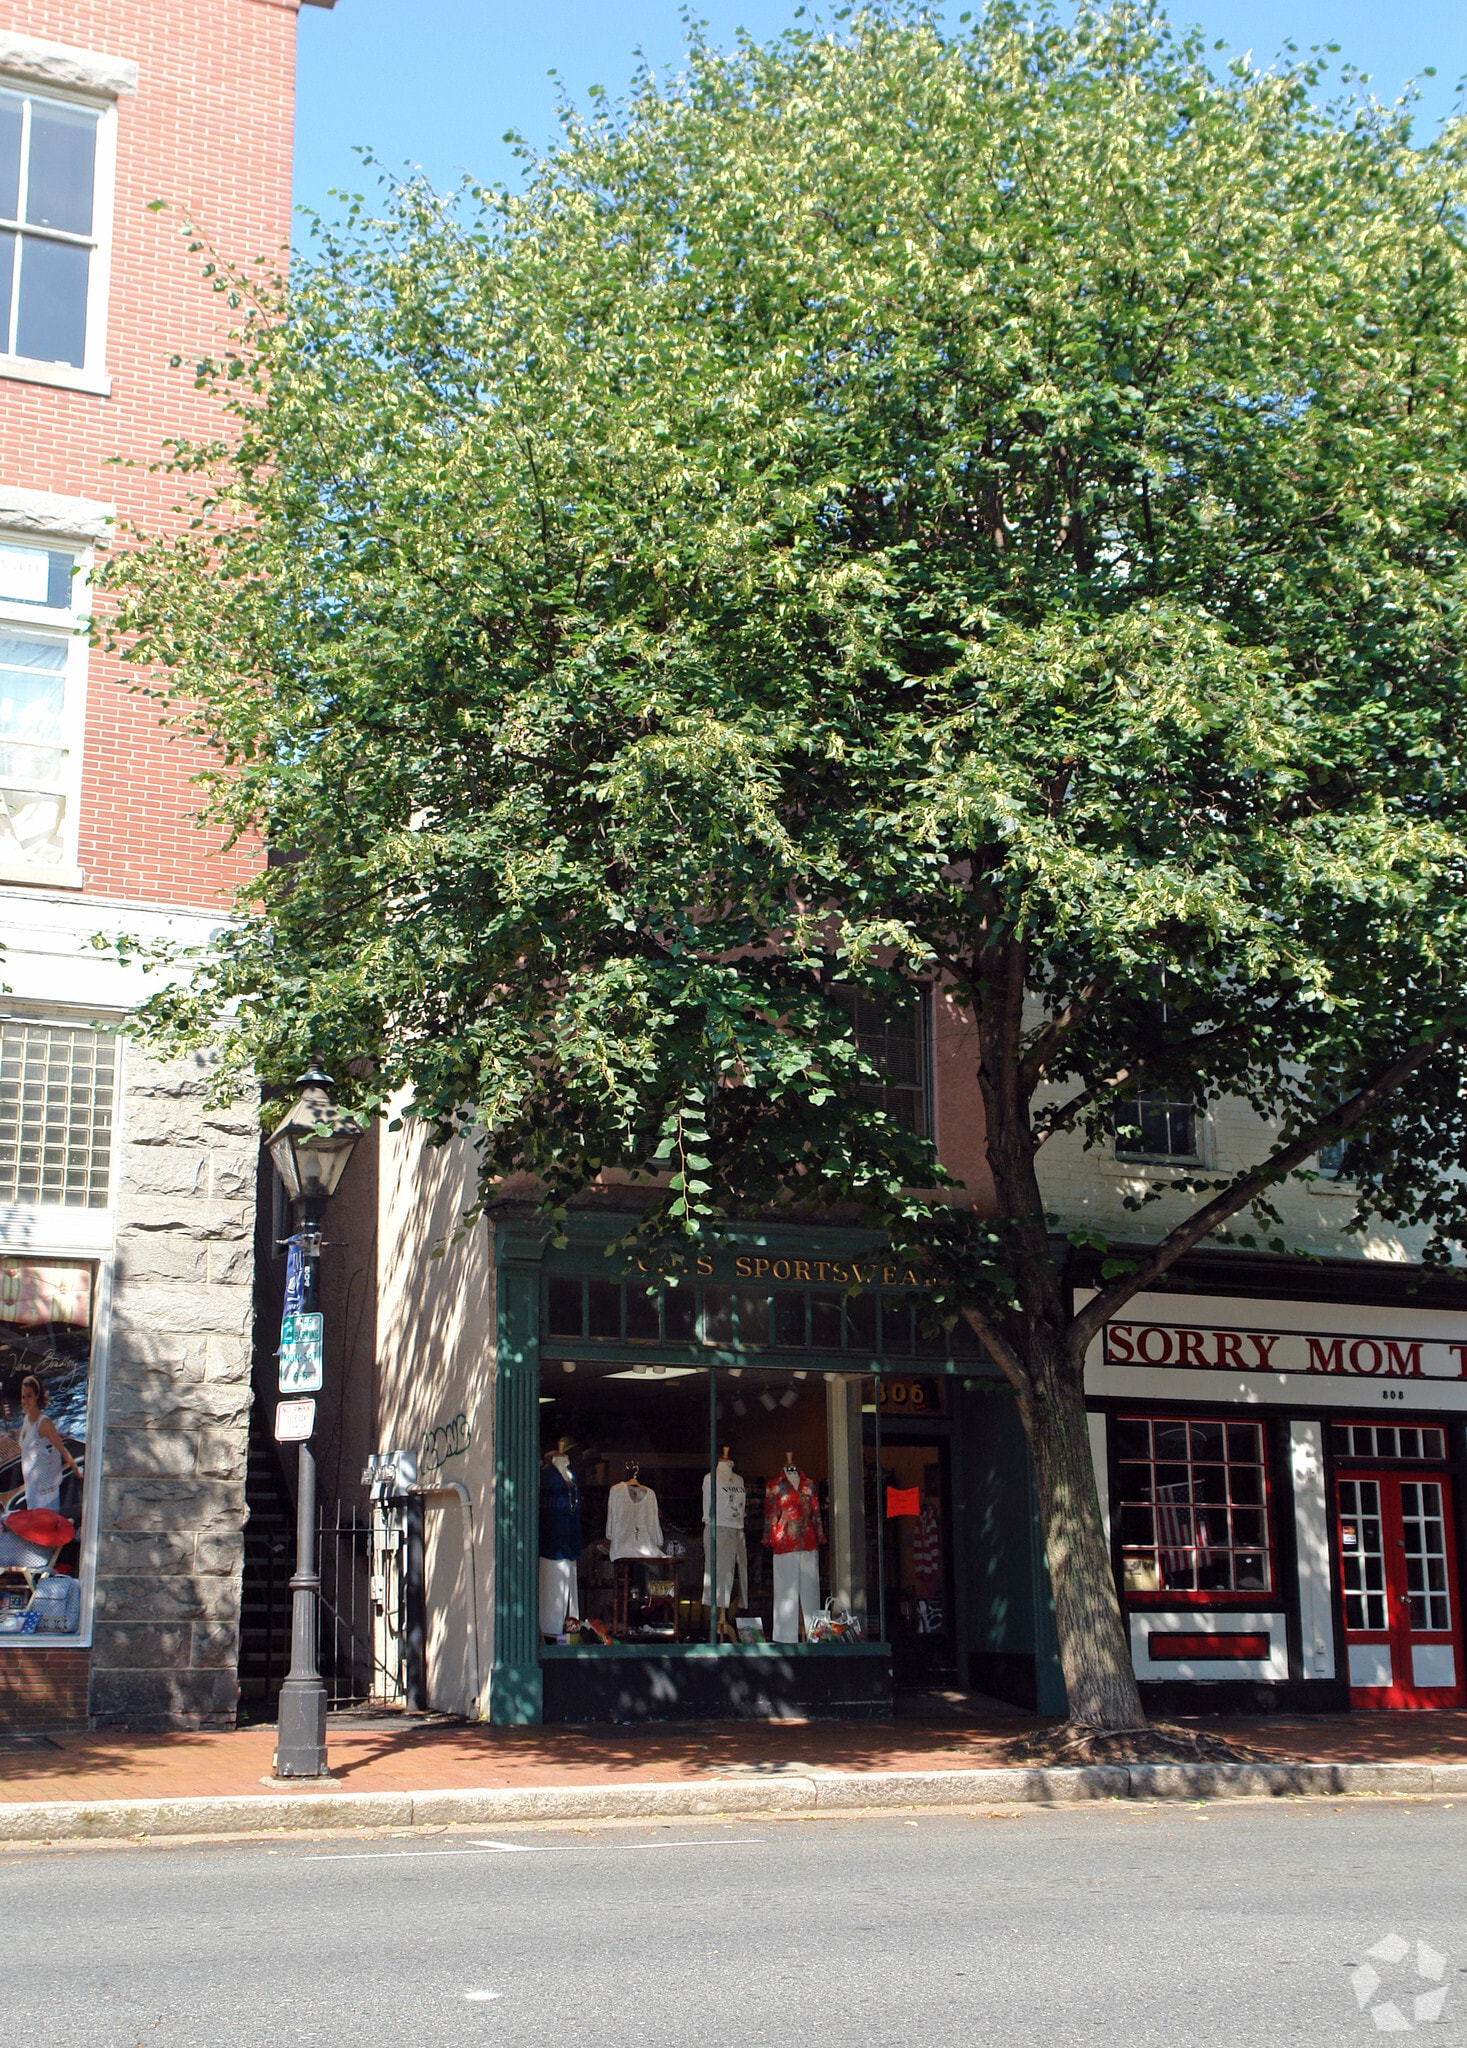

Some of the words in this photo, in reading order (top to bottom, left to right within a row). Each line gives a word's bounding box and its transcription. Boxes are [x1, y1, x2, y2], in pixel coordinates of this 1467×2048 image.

[1108, 1325, 1281, 1370] SORRY
[1305, 1338, 1426, 1377] MOM
[1382, 1390, 1404, 1400] 808
